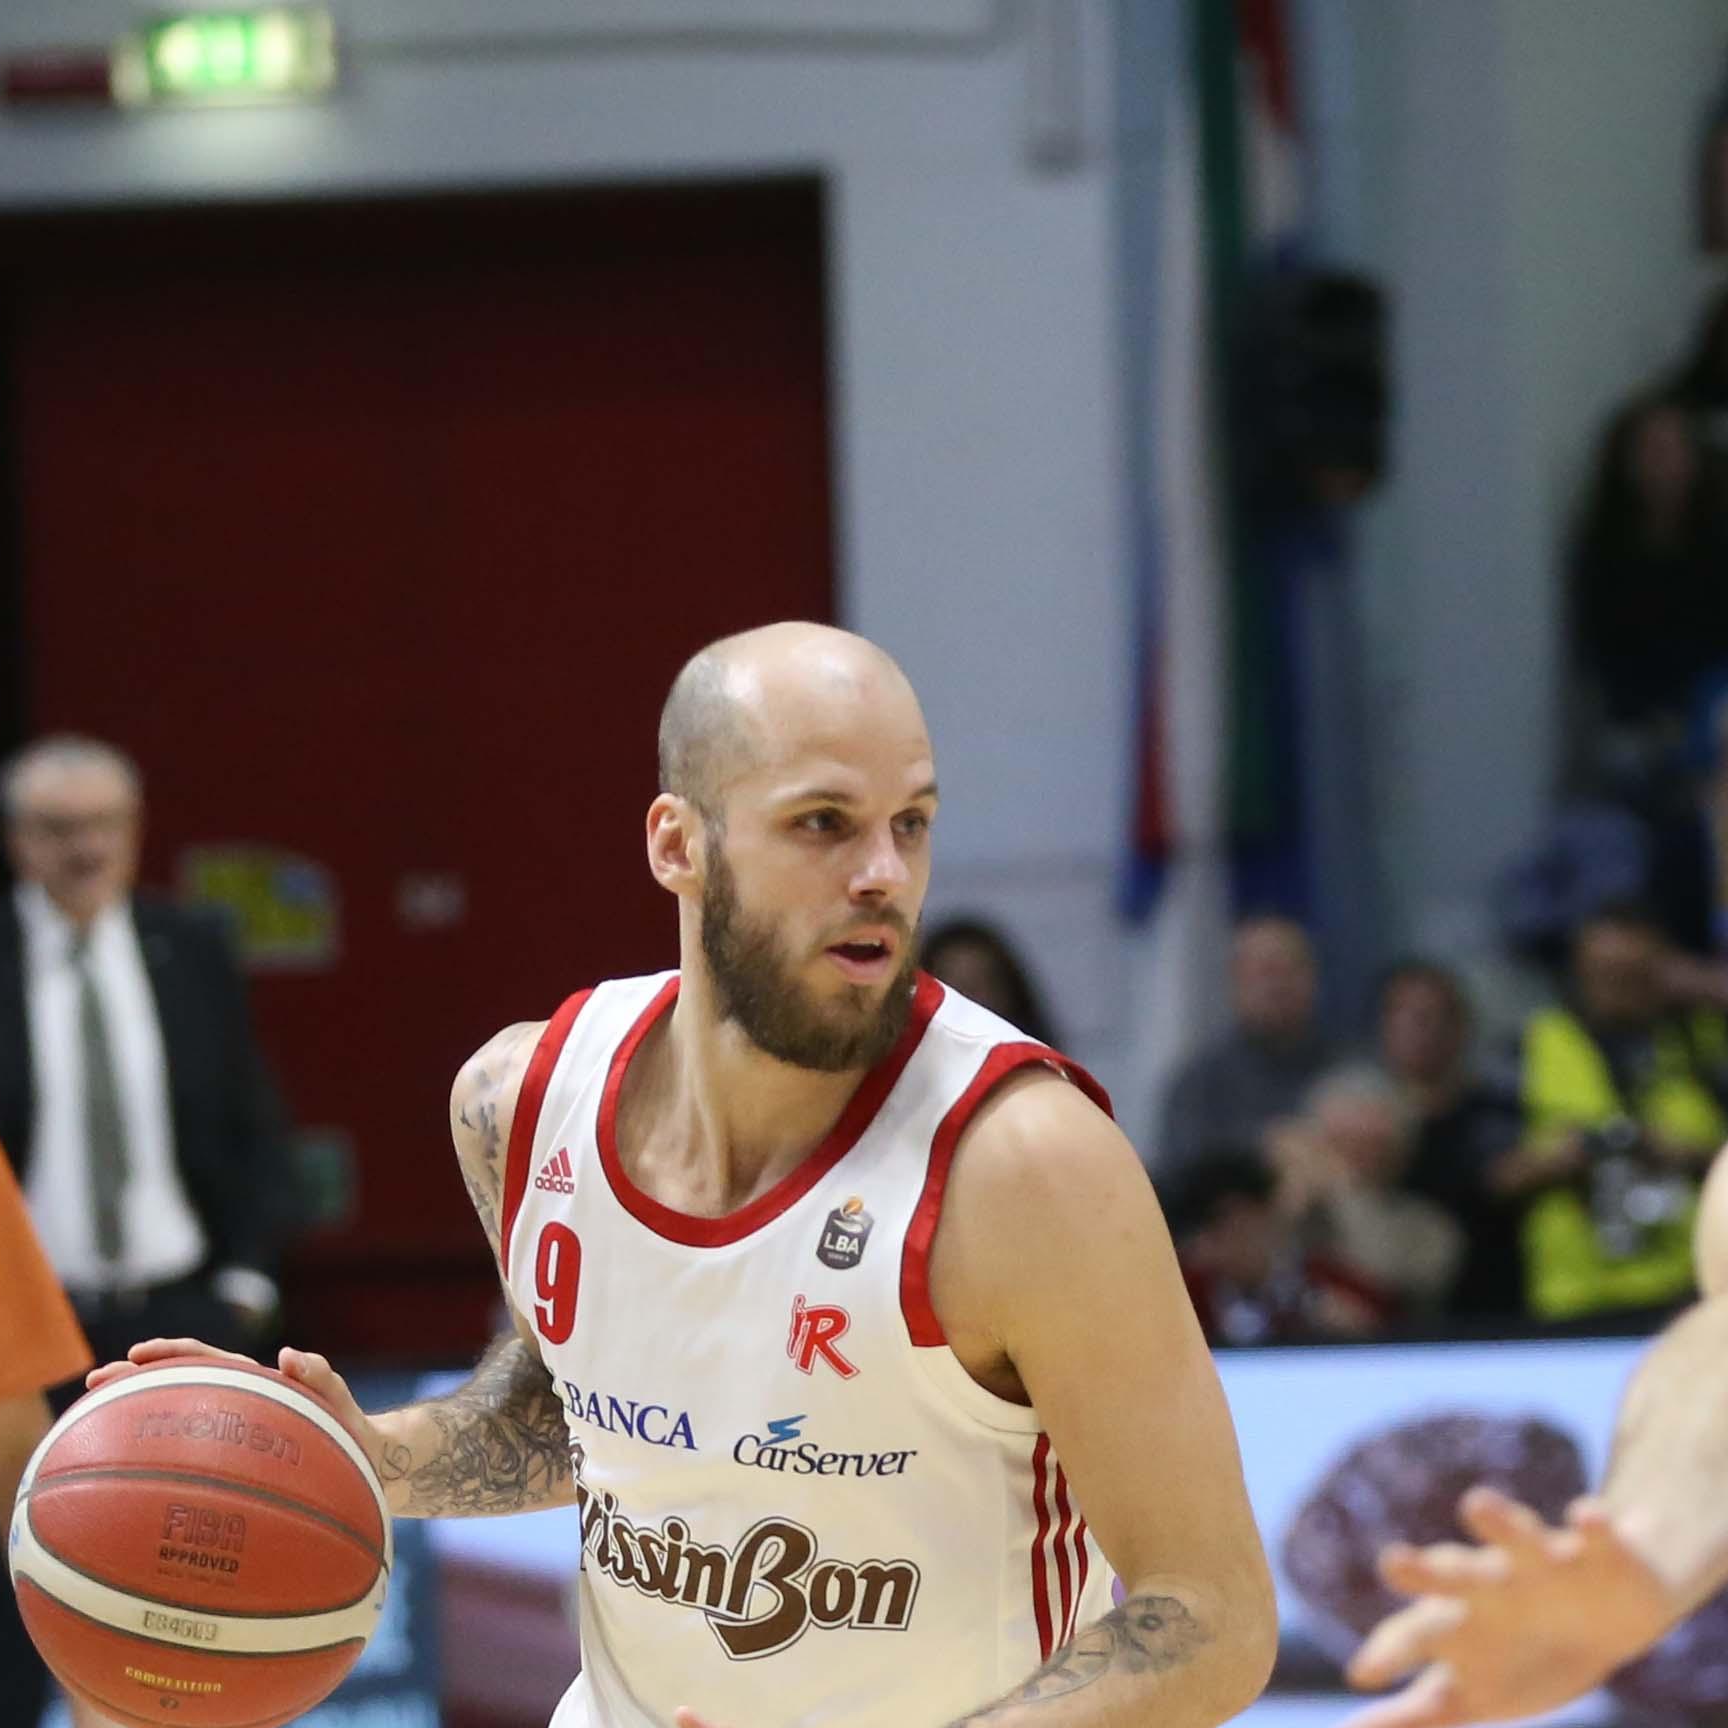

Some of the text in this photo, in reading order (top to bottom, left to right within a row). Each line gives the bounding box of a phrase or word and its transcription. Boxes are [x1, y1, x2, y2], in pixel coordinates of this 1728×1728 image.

[823, 1231, 860, 1256] LBA
[534, 1220, 582, 1345] 9
[732, 1434, 918, 1478] CarServer
[161, 1503, 248, 1553] FIBA
[158, 1545, 240, 1574] APPROVED
